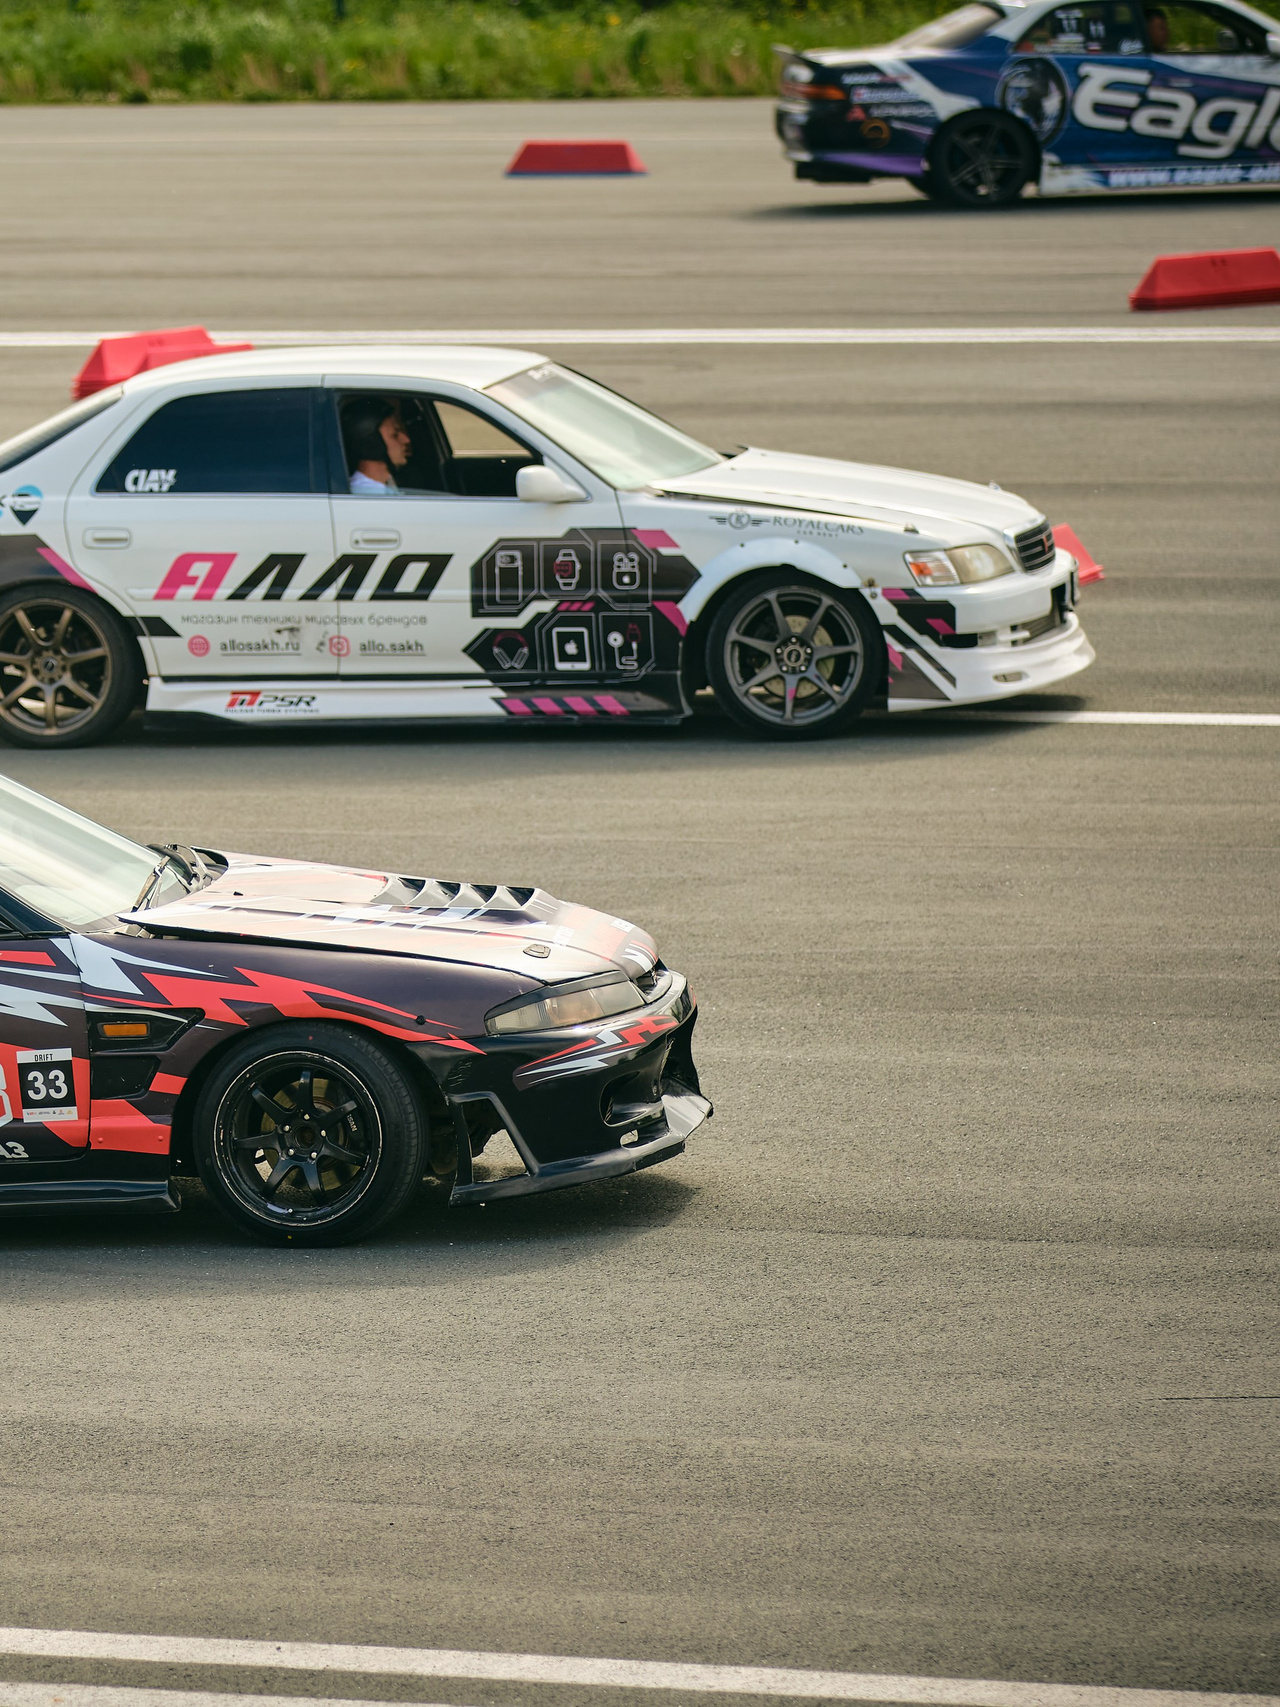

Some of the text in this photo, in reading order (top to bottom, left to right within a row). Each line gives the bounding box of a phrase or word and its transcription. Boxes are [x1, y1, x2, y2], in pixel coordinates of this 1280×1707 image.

[1073, 63, 1280, 159] Eagl
[181, 614, 238, 624] магазин
[368, 614, 427, 628] брендов
[220, 639, 300, 652] allosakh.ru
[359, 640, 424, 652] allo.sakh
[259, 694, 317, 707] PSR
[34, 1054, 53, 1062] DRIFT
[27, 1069, 68, 1100] 33
